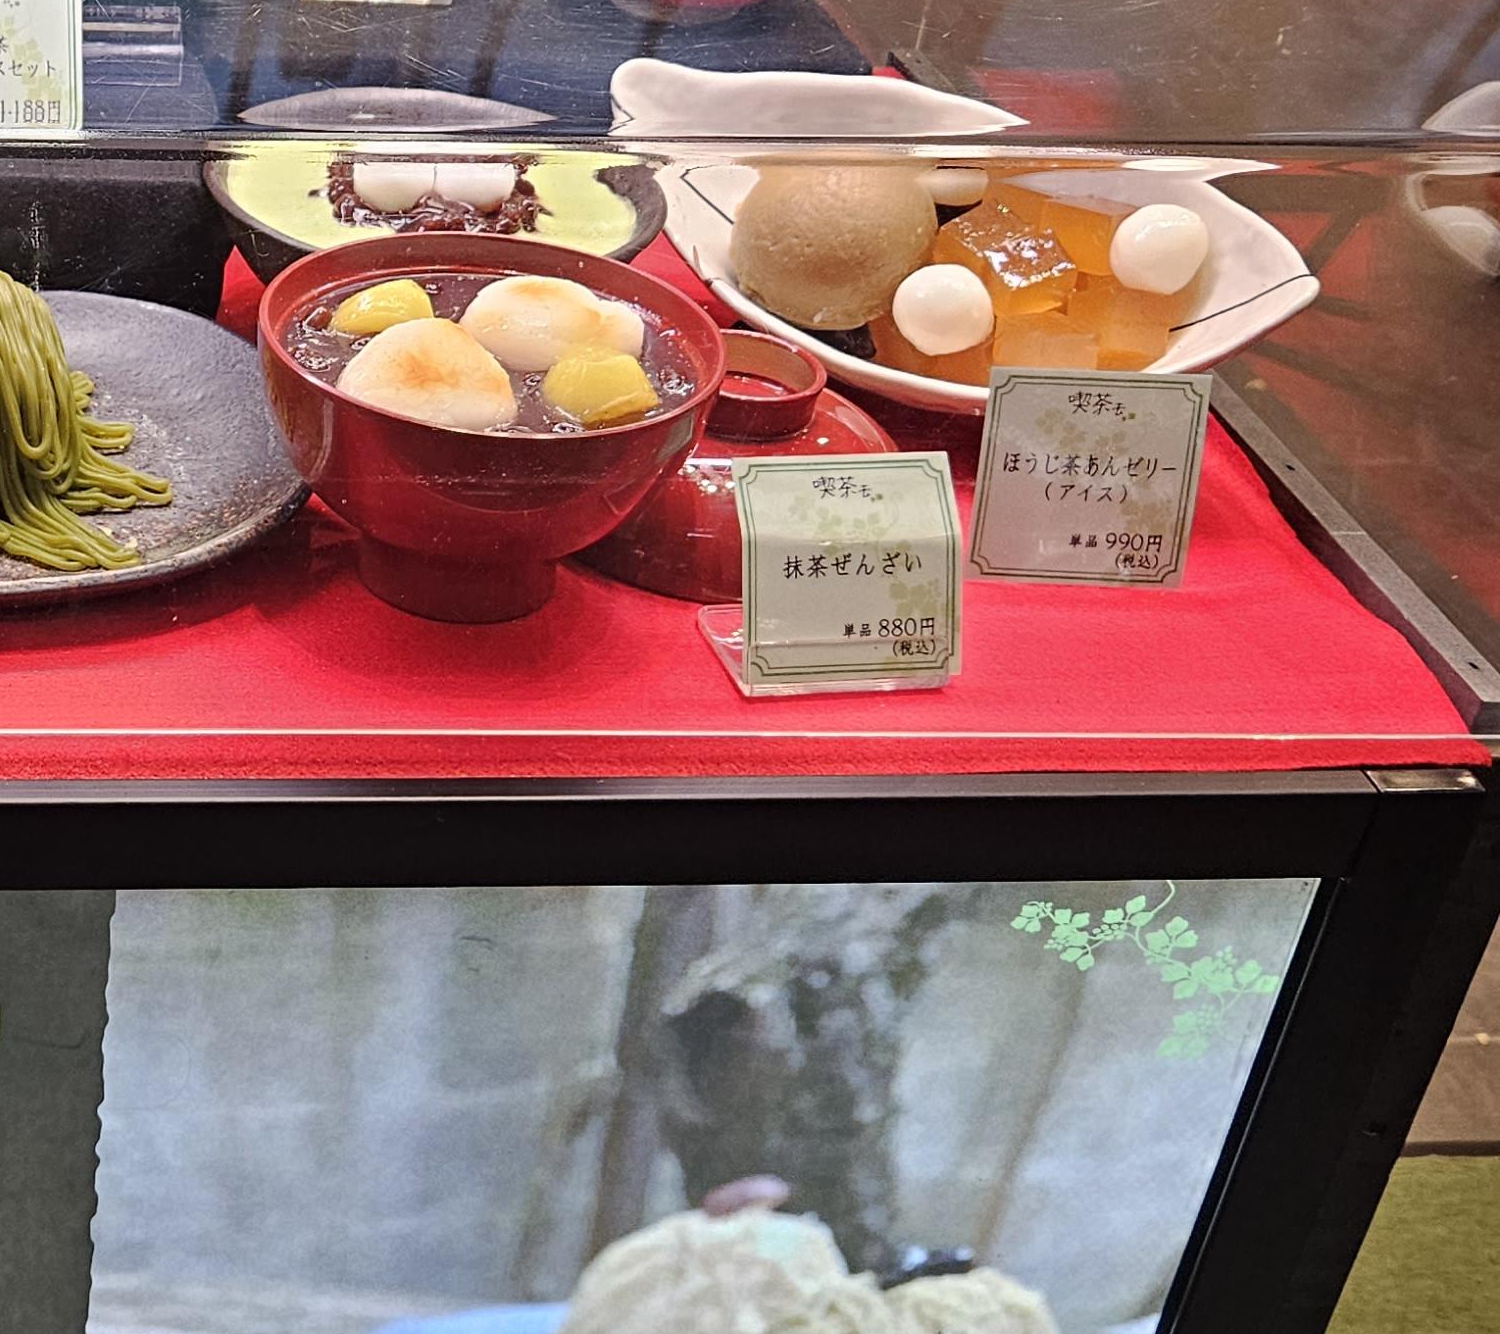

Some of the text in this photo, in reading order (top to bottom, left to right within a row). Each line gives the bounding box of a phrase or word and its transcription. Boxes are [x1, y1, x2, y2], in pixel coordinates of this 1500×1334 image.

[1003, 452, 1177, 479] ほうじ茶あんゼリー
[1068, 532, 1163, 552] 単品 990円
[783, 552, 922, 579] 抹茶ぜんざい
[843, 617, 936, 638] 単品 880円
